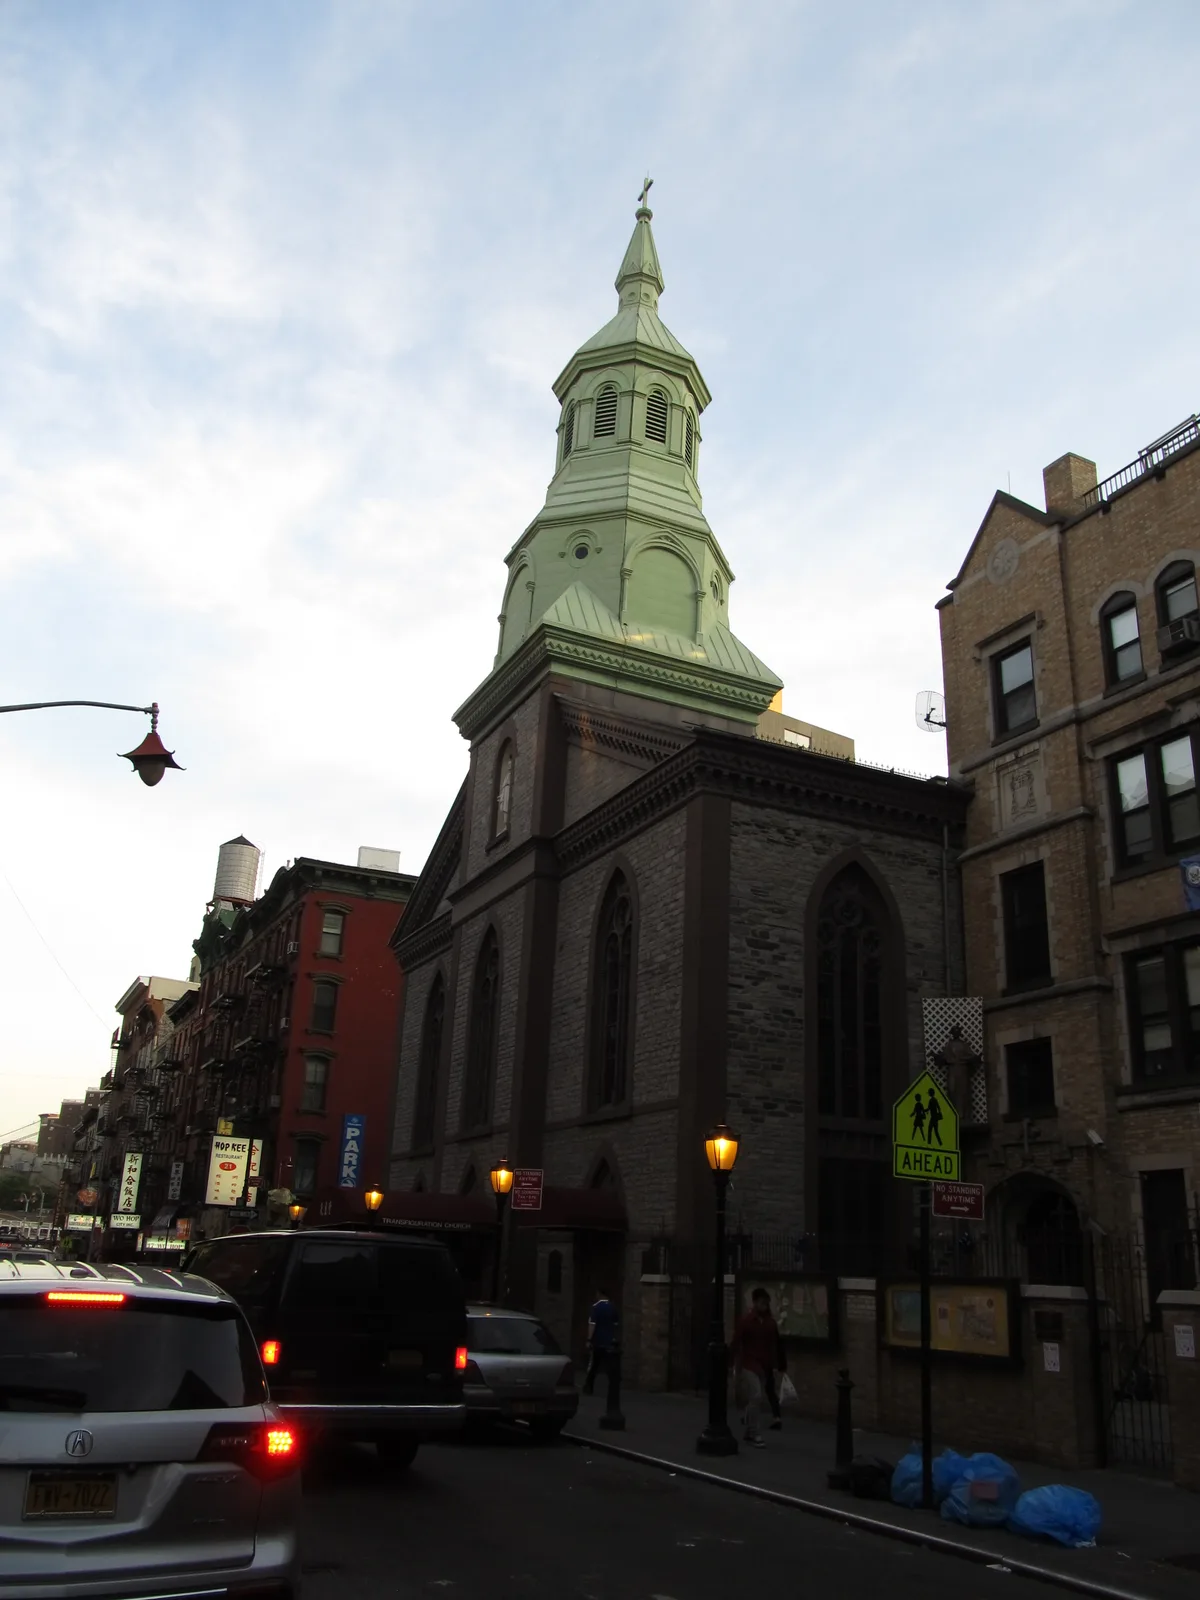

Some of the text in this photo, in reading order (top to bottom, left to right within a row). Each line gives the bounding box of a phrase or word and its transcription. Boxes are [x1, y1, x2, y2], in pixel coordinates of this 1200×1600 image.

[215, 1141, 247, 1153] HOP KEE
[342, 1127, 360, 1178] PARK
[902, 1151, 953, 1174] AHEAD
[948, 1186, 981, 1195] STANDING
[941, 1195, 976, 1204] ANYTIME
[382, 1217, 471, 1230] TRANSFIGURATION CHURCH
